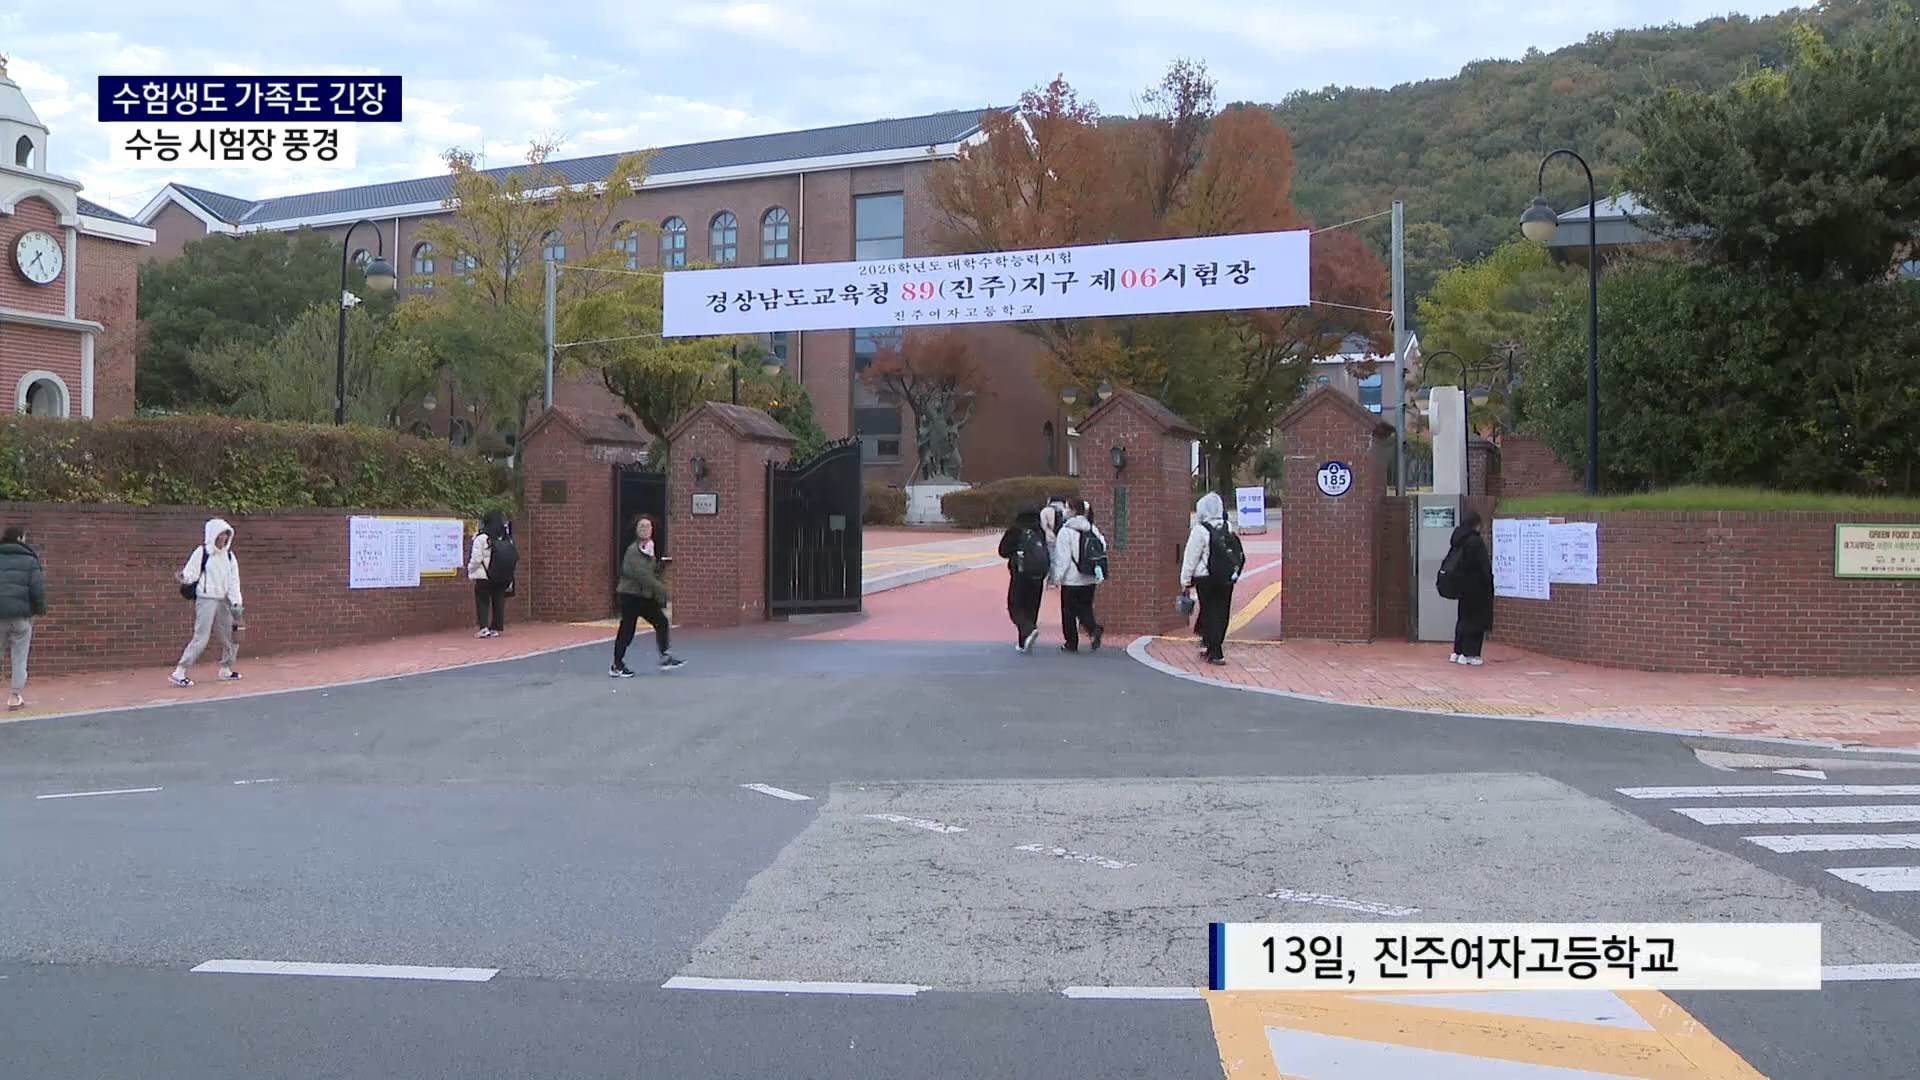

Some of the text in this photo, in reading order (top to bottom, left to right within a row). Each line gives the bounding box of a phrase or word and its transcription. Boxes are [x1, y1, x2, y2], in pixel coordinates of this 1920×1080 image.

[858, 250, 1072, 276] 2026학년도 대학수학능력시험
[705, 259, 1257, 314] 경상남도교육청 89(진주)지구 제06시험장
[1322, 474, 1347, 486] 185
[1869, 530, 1920, 539] GREEN FOOD ZO
